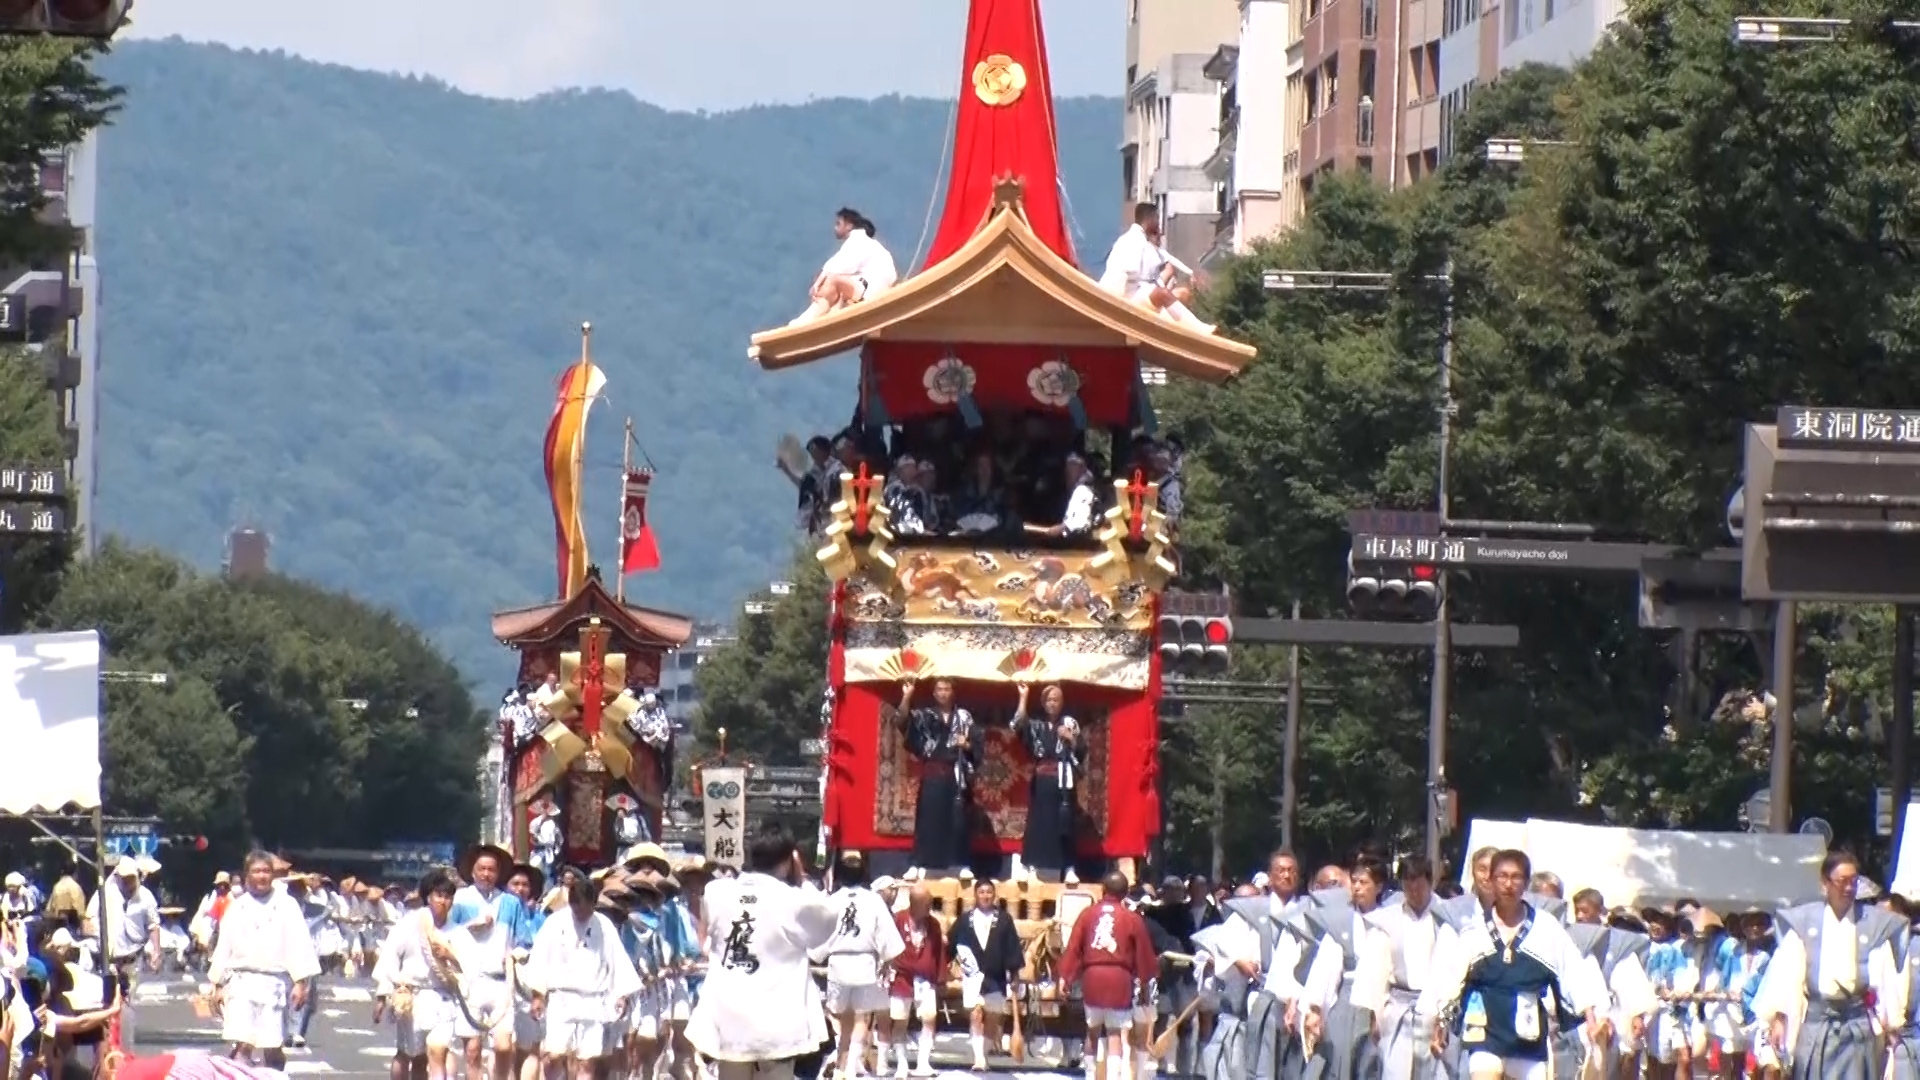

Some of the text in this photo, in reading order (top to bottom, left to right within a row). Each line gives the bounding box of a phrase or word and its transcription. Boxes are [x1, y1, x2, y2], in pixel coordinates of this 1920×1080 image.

[1792, 410, 1920, 442] 東洞院通
[1364, 537, 1465, 562] 車屋町通
[1477, 547, 1568, 560] Kurumayacho dori
[712, 808, 735, 859] 大船
